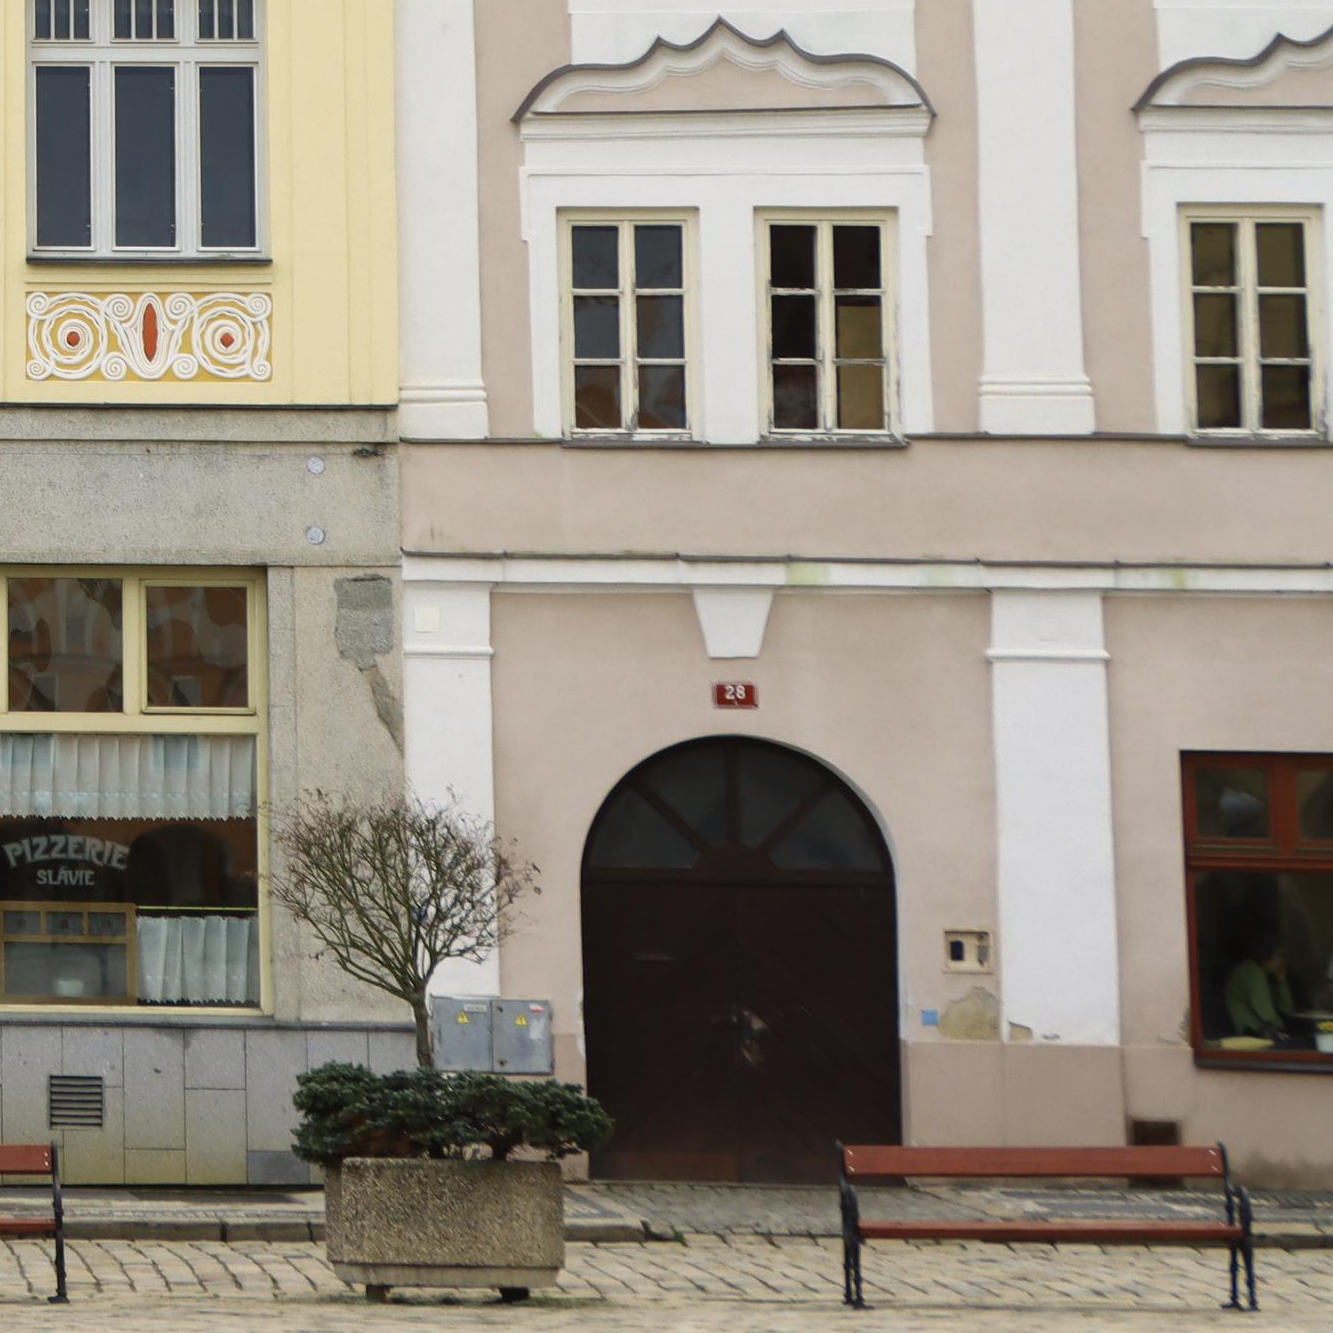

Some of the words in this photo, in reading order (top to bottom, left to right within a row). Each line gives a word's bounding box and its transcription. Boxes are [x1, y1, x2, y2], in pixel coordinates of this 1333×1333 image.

[724, 684, 746, 700] 28
[1, 834, 130, 870] PIZZERIE
[36, 866, 95, 886] SLÁVIE
